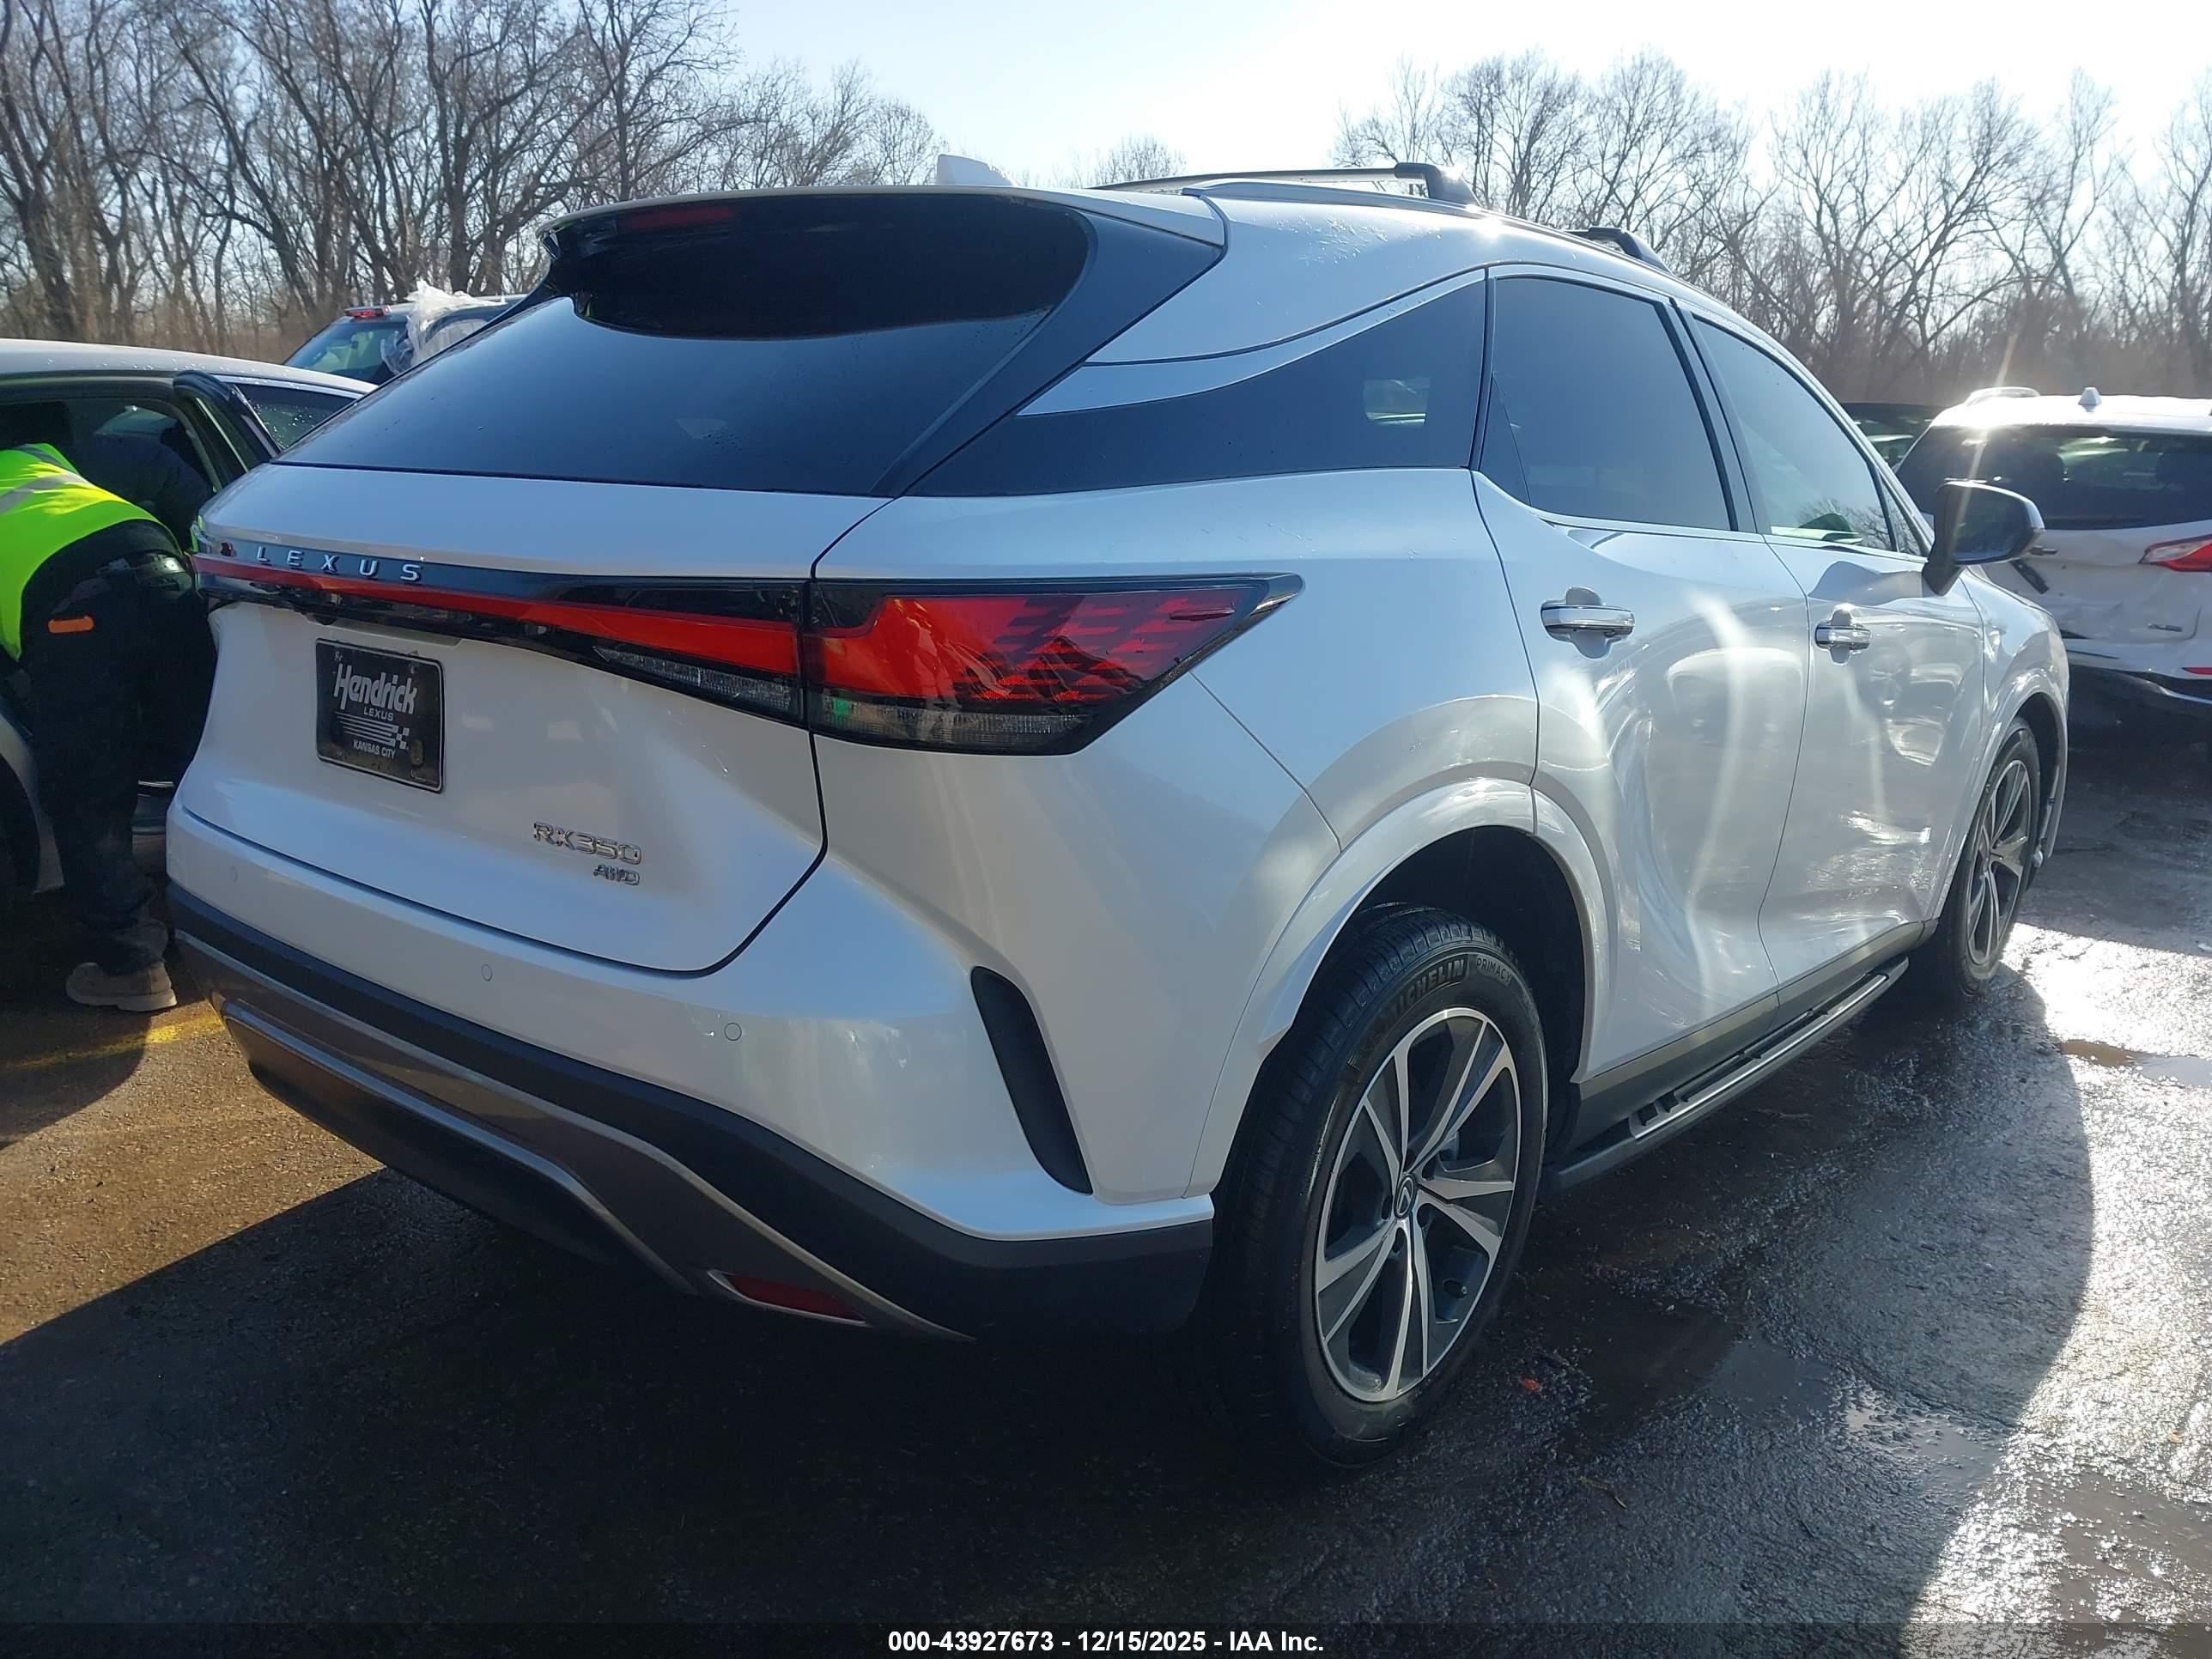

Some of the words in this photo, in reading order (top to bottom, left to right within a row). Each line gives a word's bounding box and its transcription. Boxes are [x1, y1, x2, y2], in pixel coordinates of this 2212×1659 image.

[257, 545, 422, 582] LEXUS
[333, 663, 418, 714] Hendrick
[363, 707, 394, 721] LEXUS
[353, 738, 380, 756] KANSAS
[381, 748, 397, 759] CITY
[532, 821, 642, 865] RX350
[592, 864, 641, 885] AWD
[1476, 957, 1512, 983] PRIMACY
